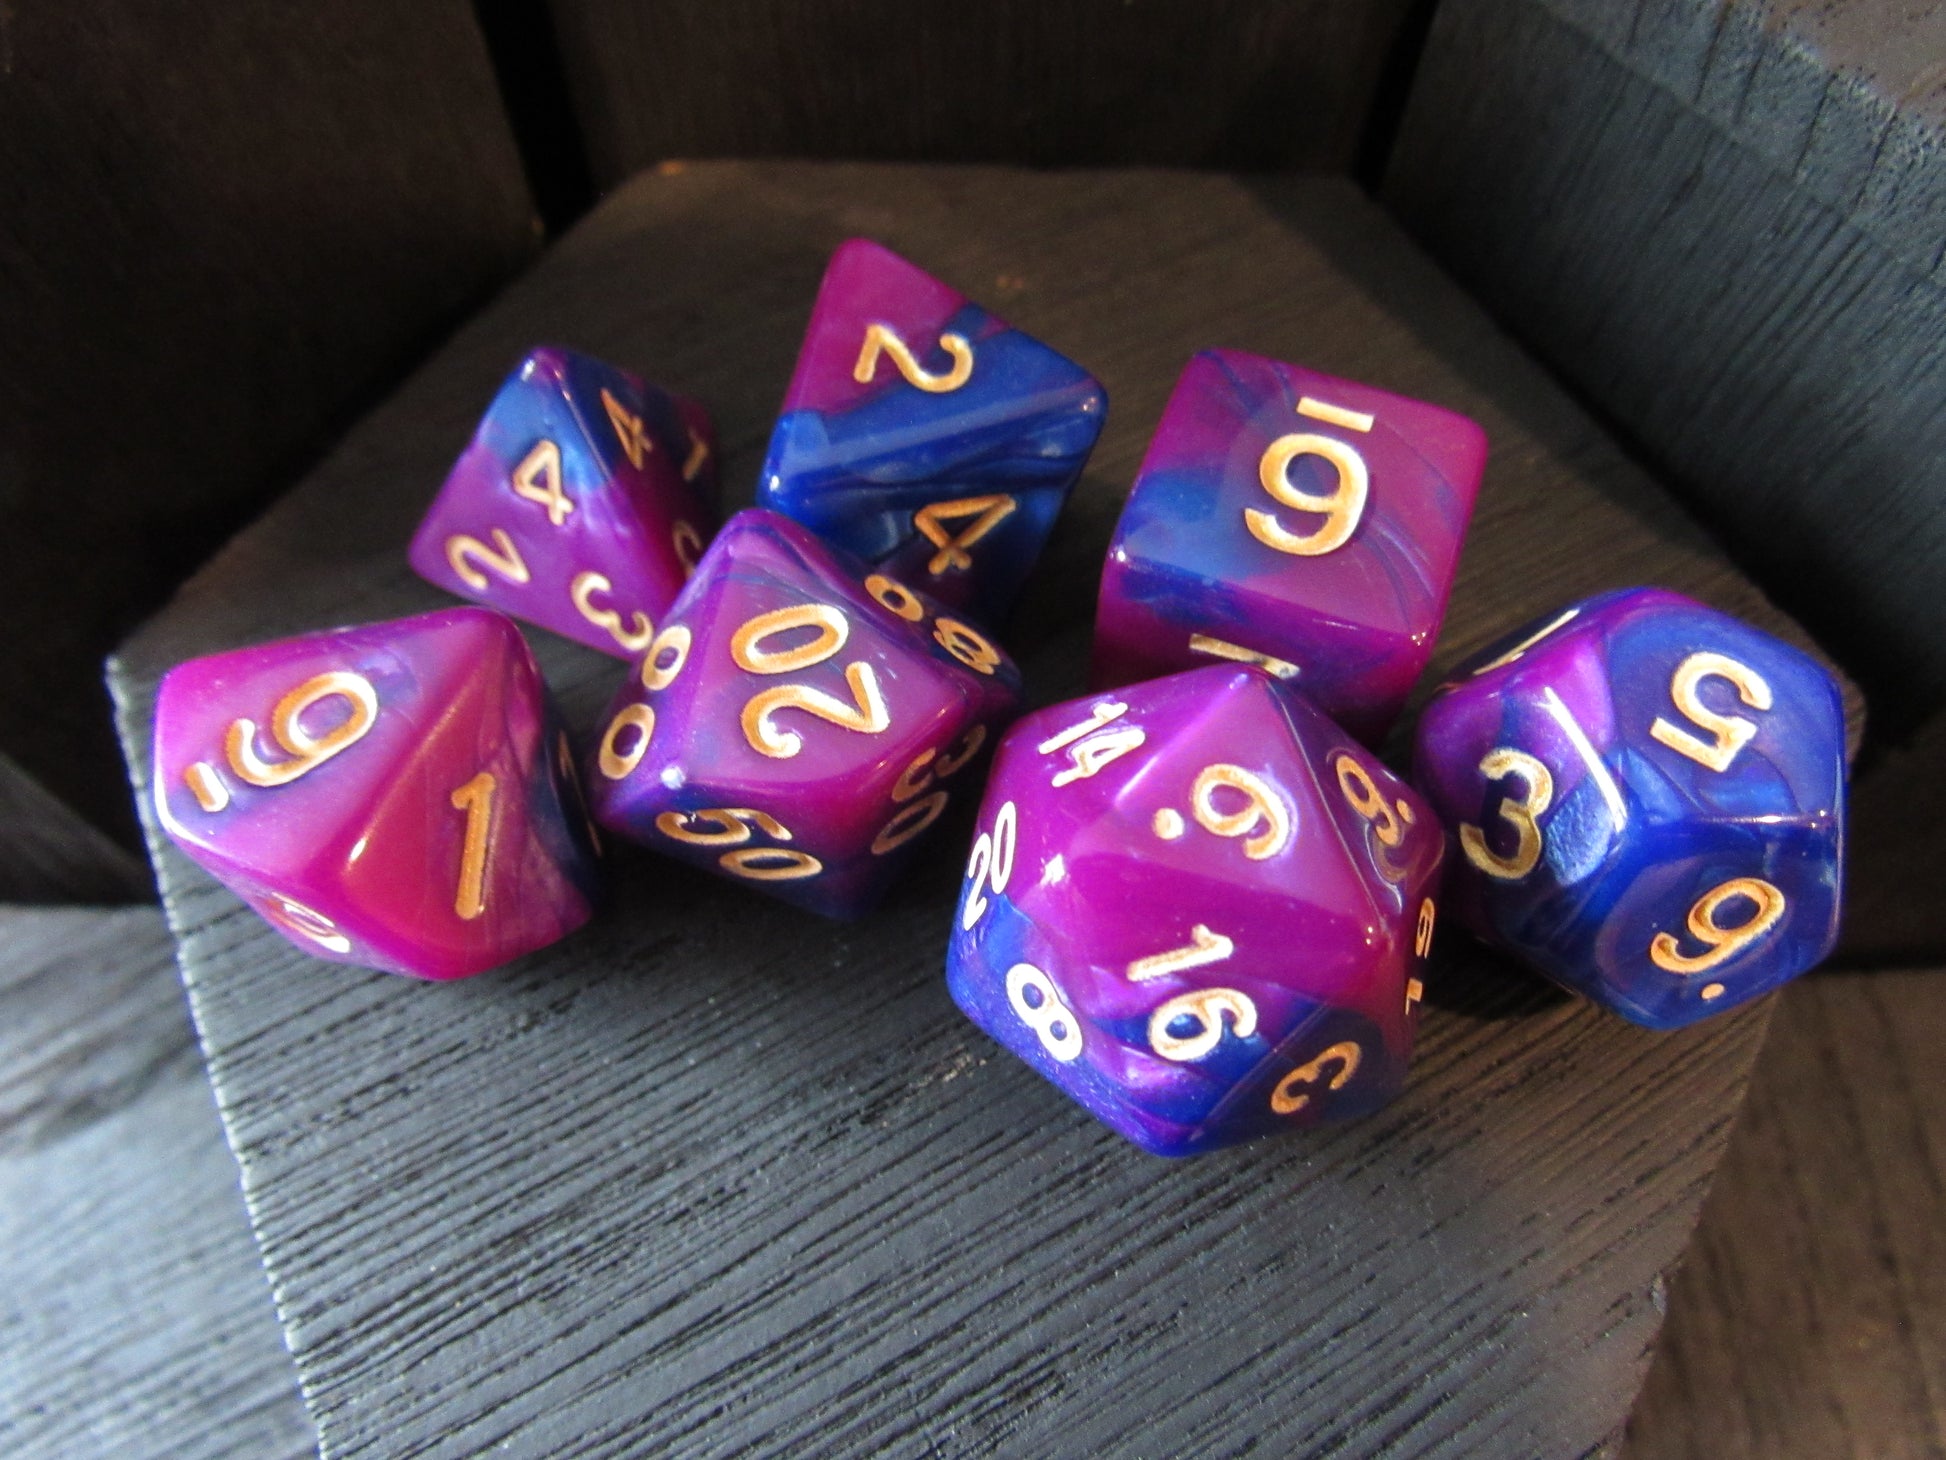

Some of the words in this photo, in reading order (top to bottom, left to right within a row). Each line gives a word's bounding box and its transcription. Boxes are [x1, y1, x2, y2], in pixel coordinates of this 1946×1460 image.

[853, 324, 974, 392] 2
[601, 387, 653, 471] 4
[513, 439, 574, 526] 4
[445, 528, 530, 591] 2
[914, 494, 1016, 575] 4
[571, 571, 653, 651] 3
[1038, 702, 1146, 788] 14
[1650, 651, 1773, 772] 5
[451, 772, 496, 920] 1
[1460, 748, 1553, 879] 3
[963, 801, 1017, 932] 20
[1005, 963, 1083, 1062] 8
[1126, 924, 1257, 1062] 16
[1272, 1042, 1361, 1114] 3
